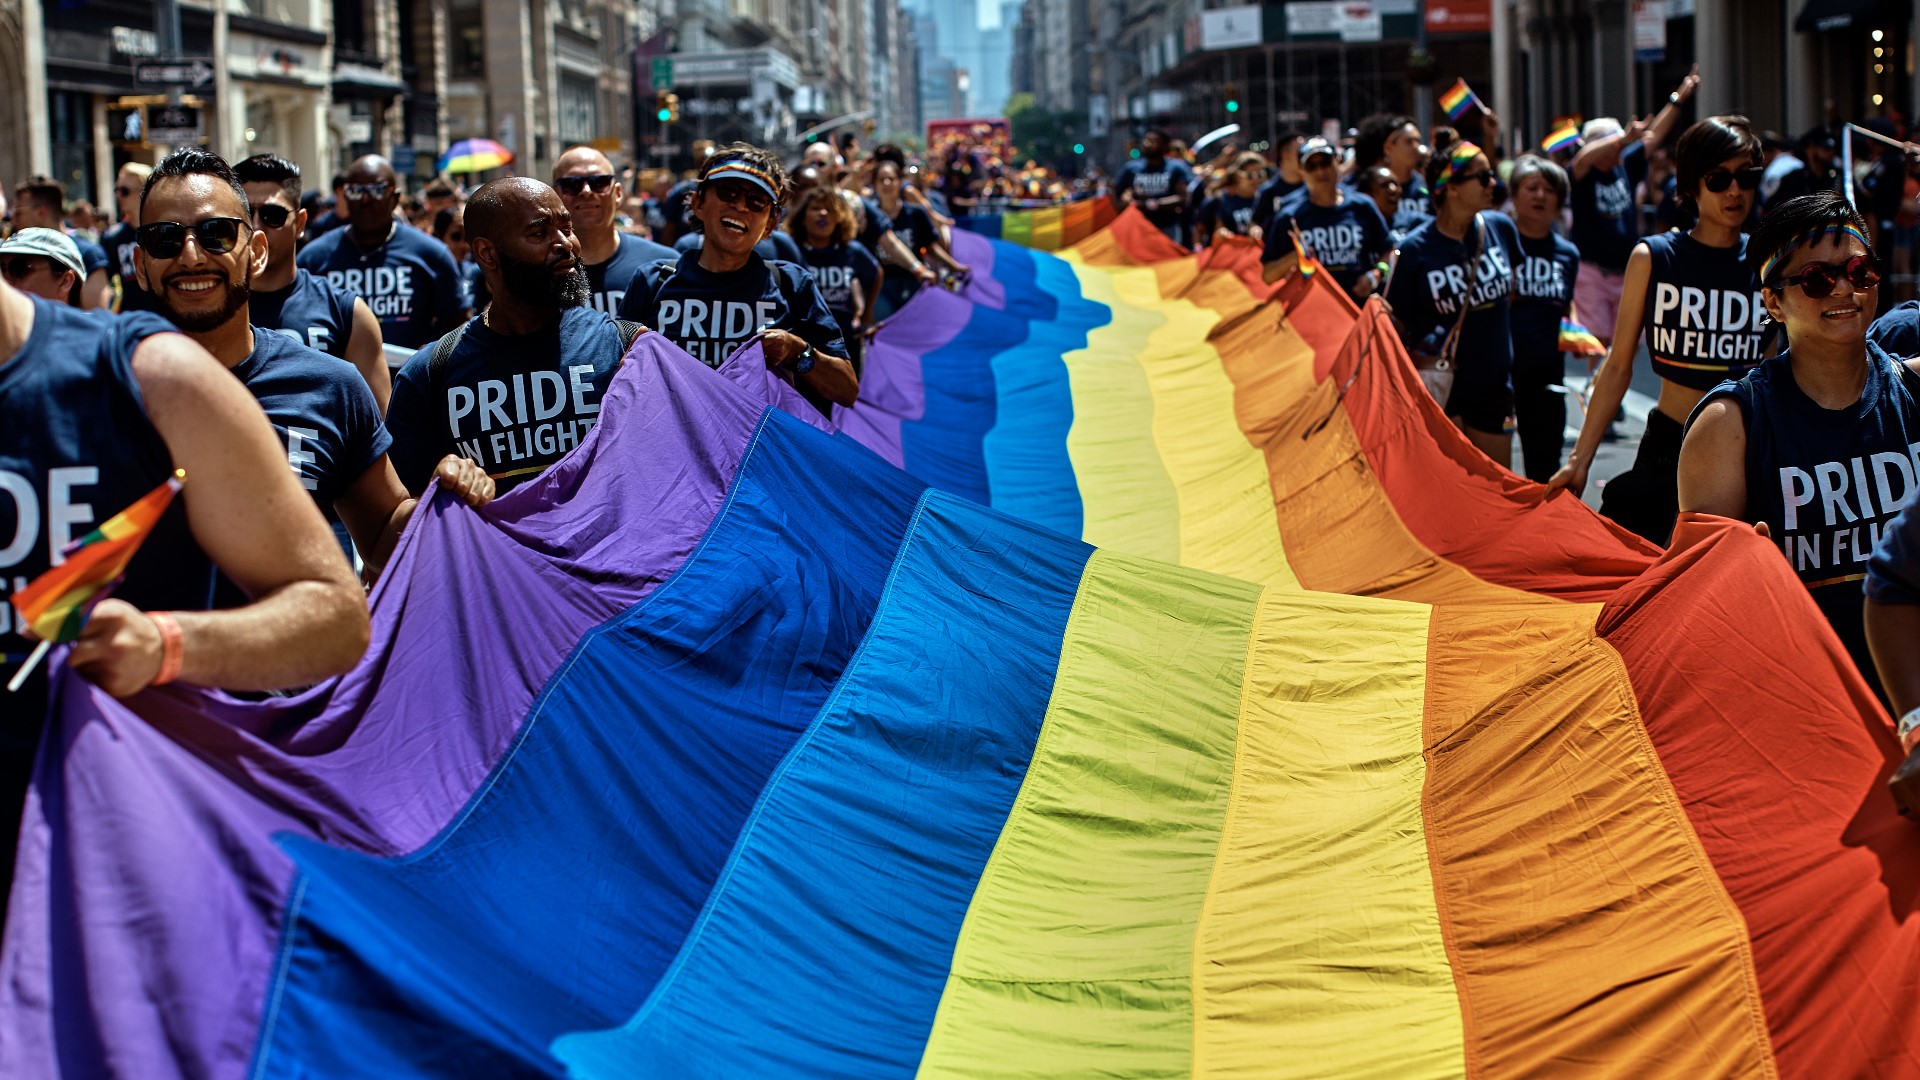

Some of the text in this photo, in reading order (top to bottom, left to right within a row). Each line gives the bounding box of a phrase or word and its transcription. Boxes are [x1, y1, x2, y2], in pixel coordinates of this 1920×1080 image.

[1300, 225, 1363, 252] PRIDE
[327, 266, 414, 296] PRIDE
[658, 299, 777, 338] PRIDE
[1435, 297, 1456, 315] IN
[1654, 282, 1768, 332] PRIDE
[1653, 325, 1764, 359] IN FLIGHT.
[447, 364, 600, 439] PRIDE
[456, 438, 485, 467] IN
[1784, 533, 1821, 571] IN
